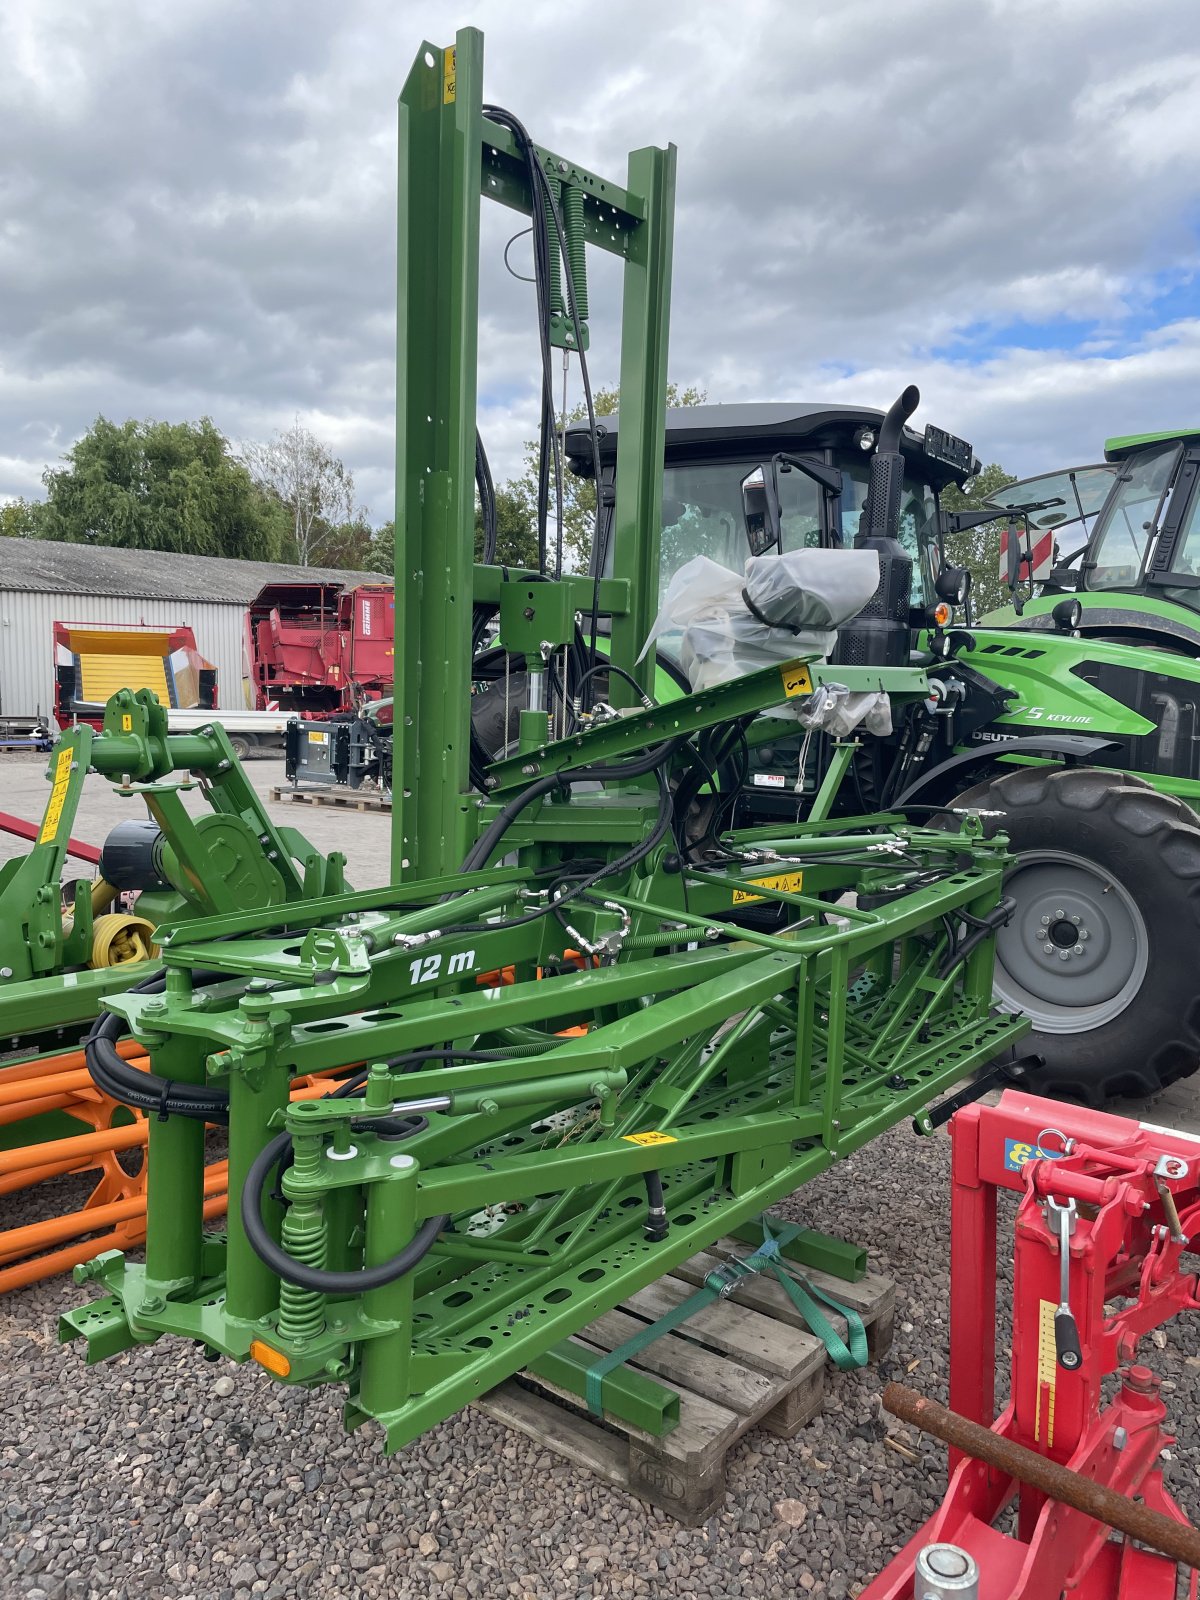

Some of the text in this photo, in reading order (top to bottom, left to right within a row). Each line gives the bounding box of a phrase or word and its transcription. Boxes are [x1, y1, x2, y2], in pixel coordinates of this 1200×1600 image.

[362, 600, 371, 635] GRIMME
[1046, 713, 1094, 724] KEYLINE
[409, 950, 475, 985] 12 m
[645, 1463, 681, 1498] EPAL
